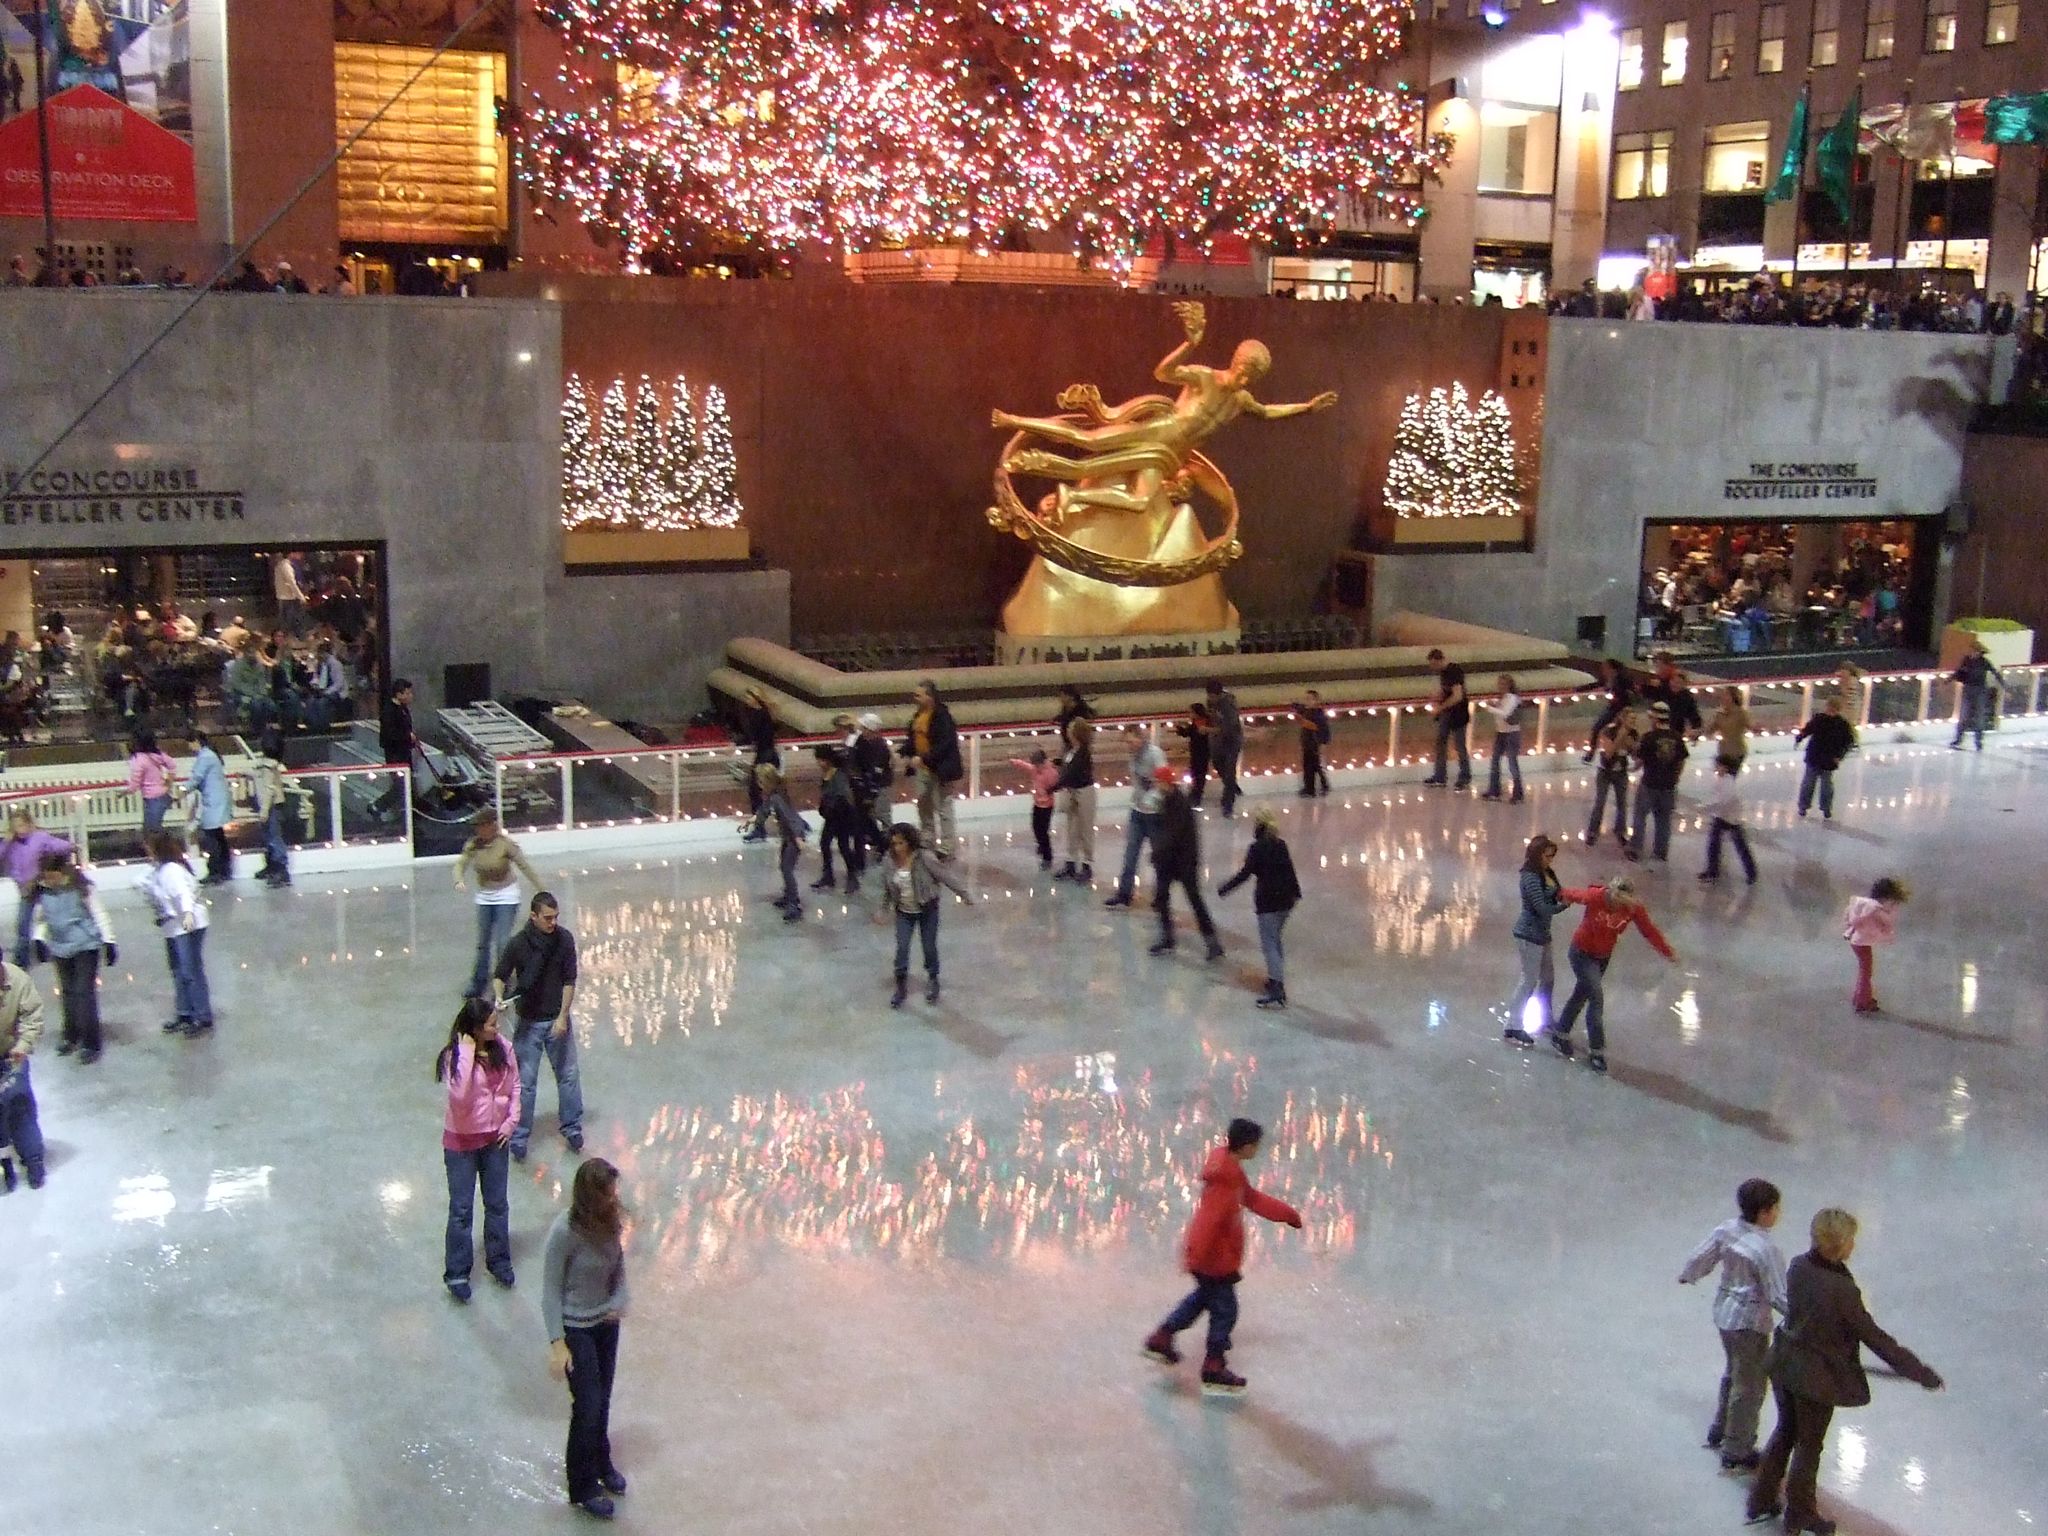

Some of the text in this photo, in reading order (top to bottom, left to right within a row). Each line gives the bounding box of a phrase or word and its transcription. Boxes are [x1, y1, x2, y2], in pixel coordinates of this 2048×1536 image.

[4, 168, 175, 189] OBSRVATION DECK
[29, 468, 200, 492] CONCOURSE
[136, 499, 246, 523] CENTER
